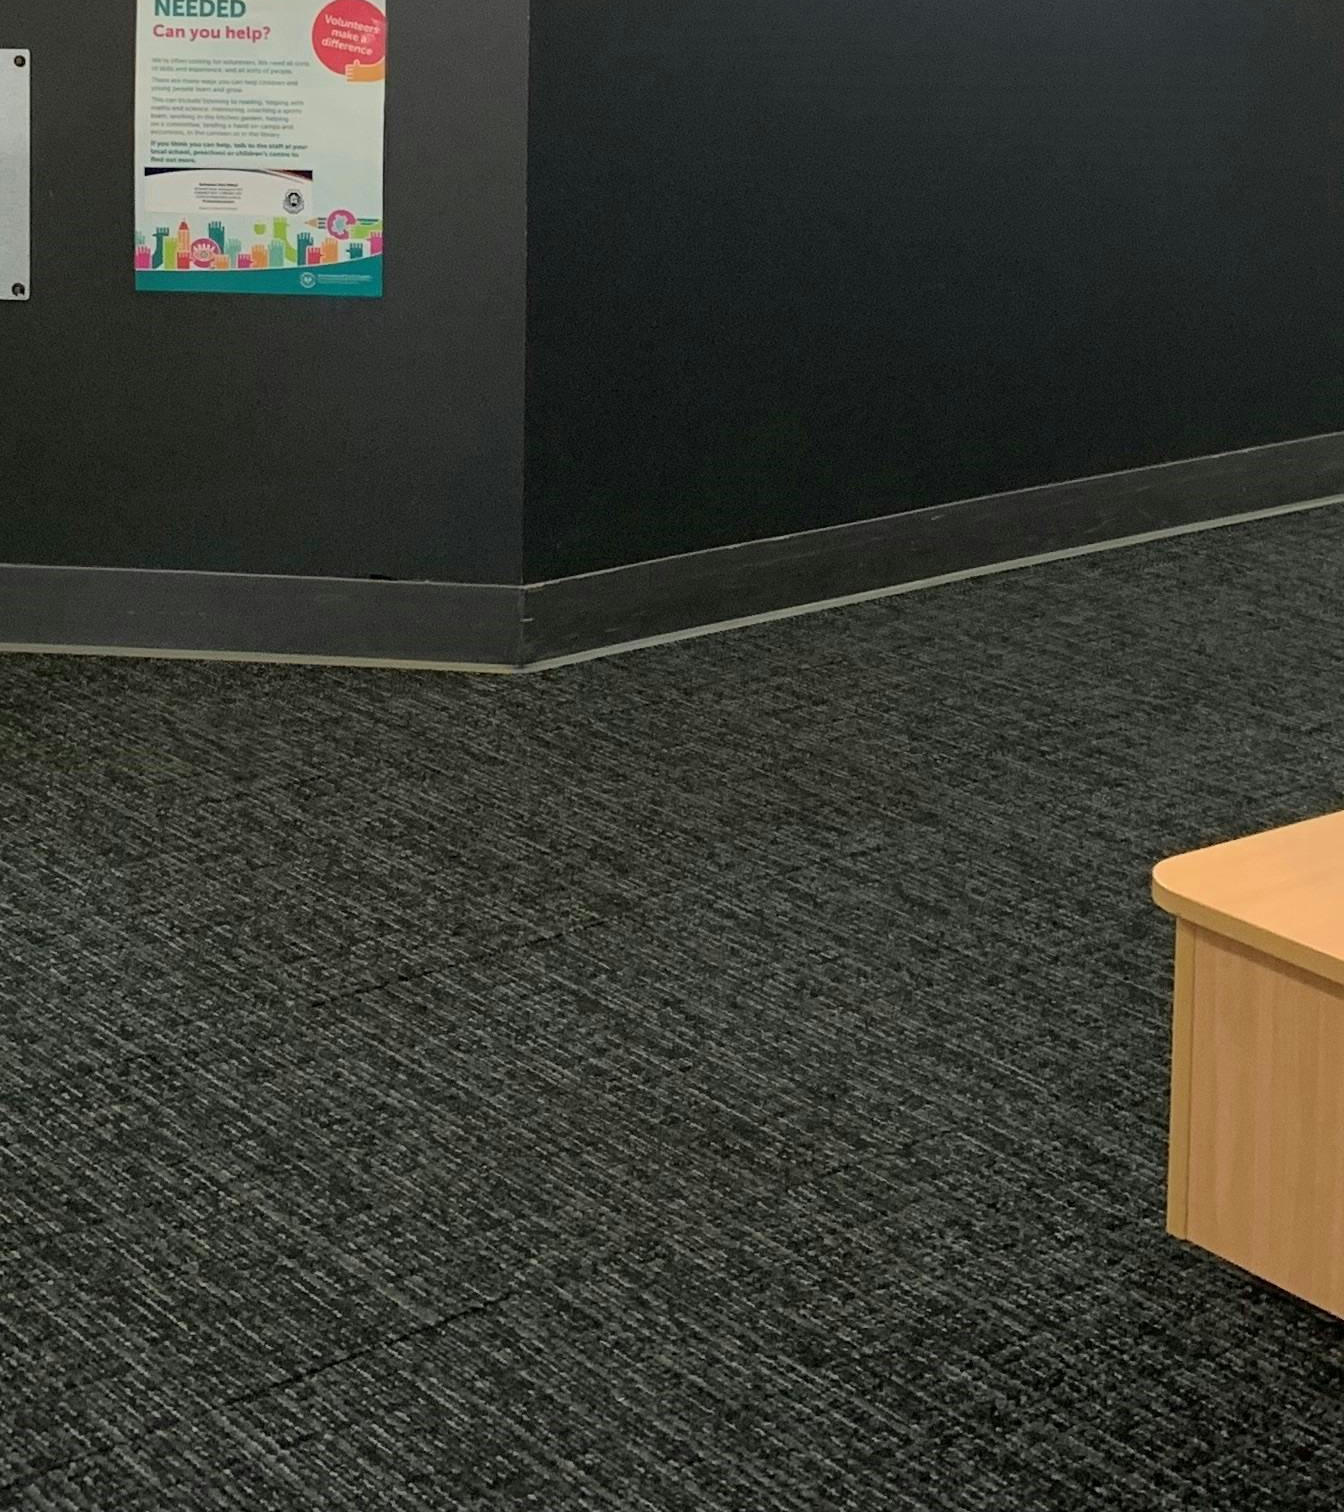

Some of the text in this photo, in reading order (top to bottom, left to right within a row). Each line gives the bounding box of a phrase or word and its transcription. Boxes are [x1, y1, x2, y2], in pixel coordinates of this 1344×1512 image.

[324, 13, 381, 35] Volunteers
[152, 24, 271, 44] Can you help?
[331, 29, 360, 42] make
[321, 37, 374, 56] difference
